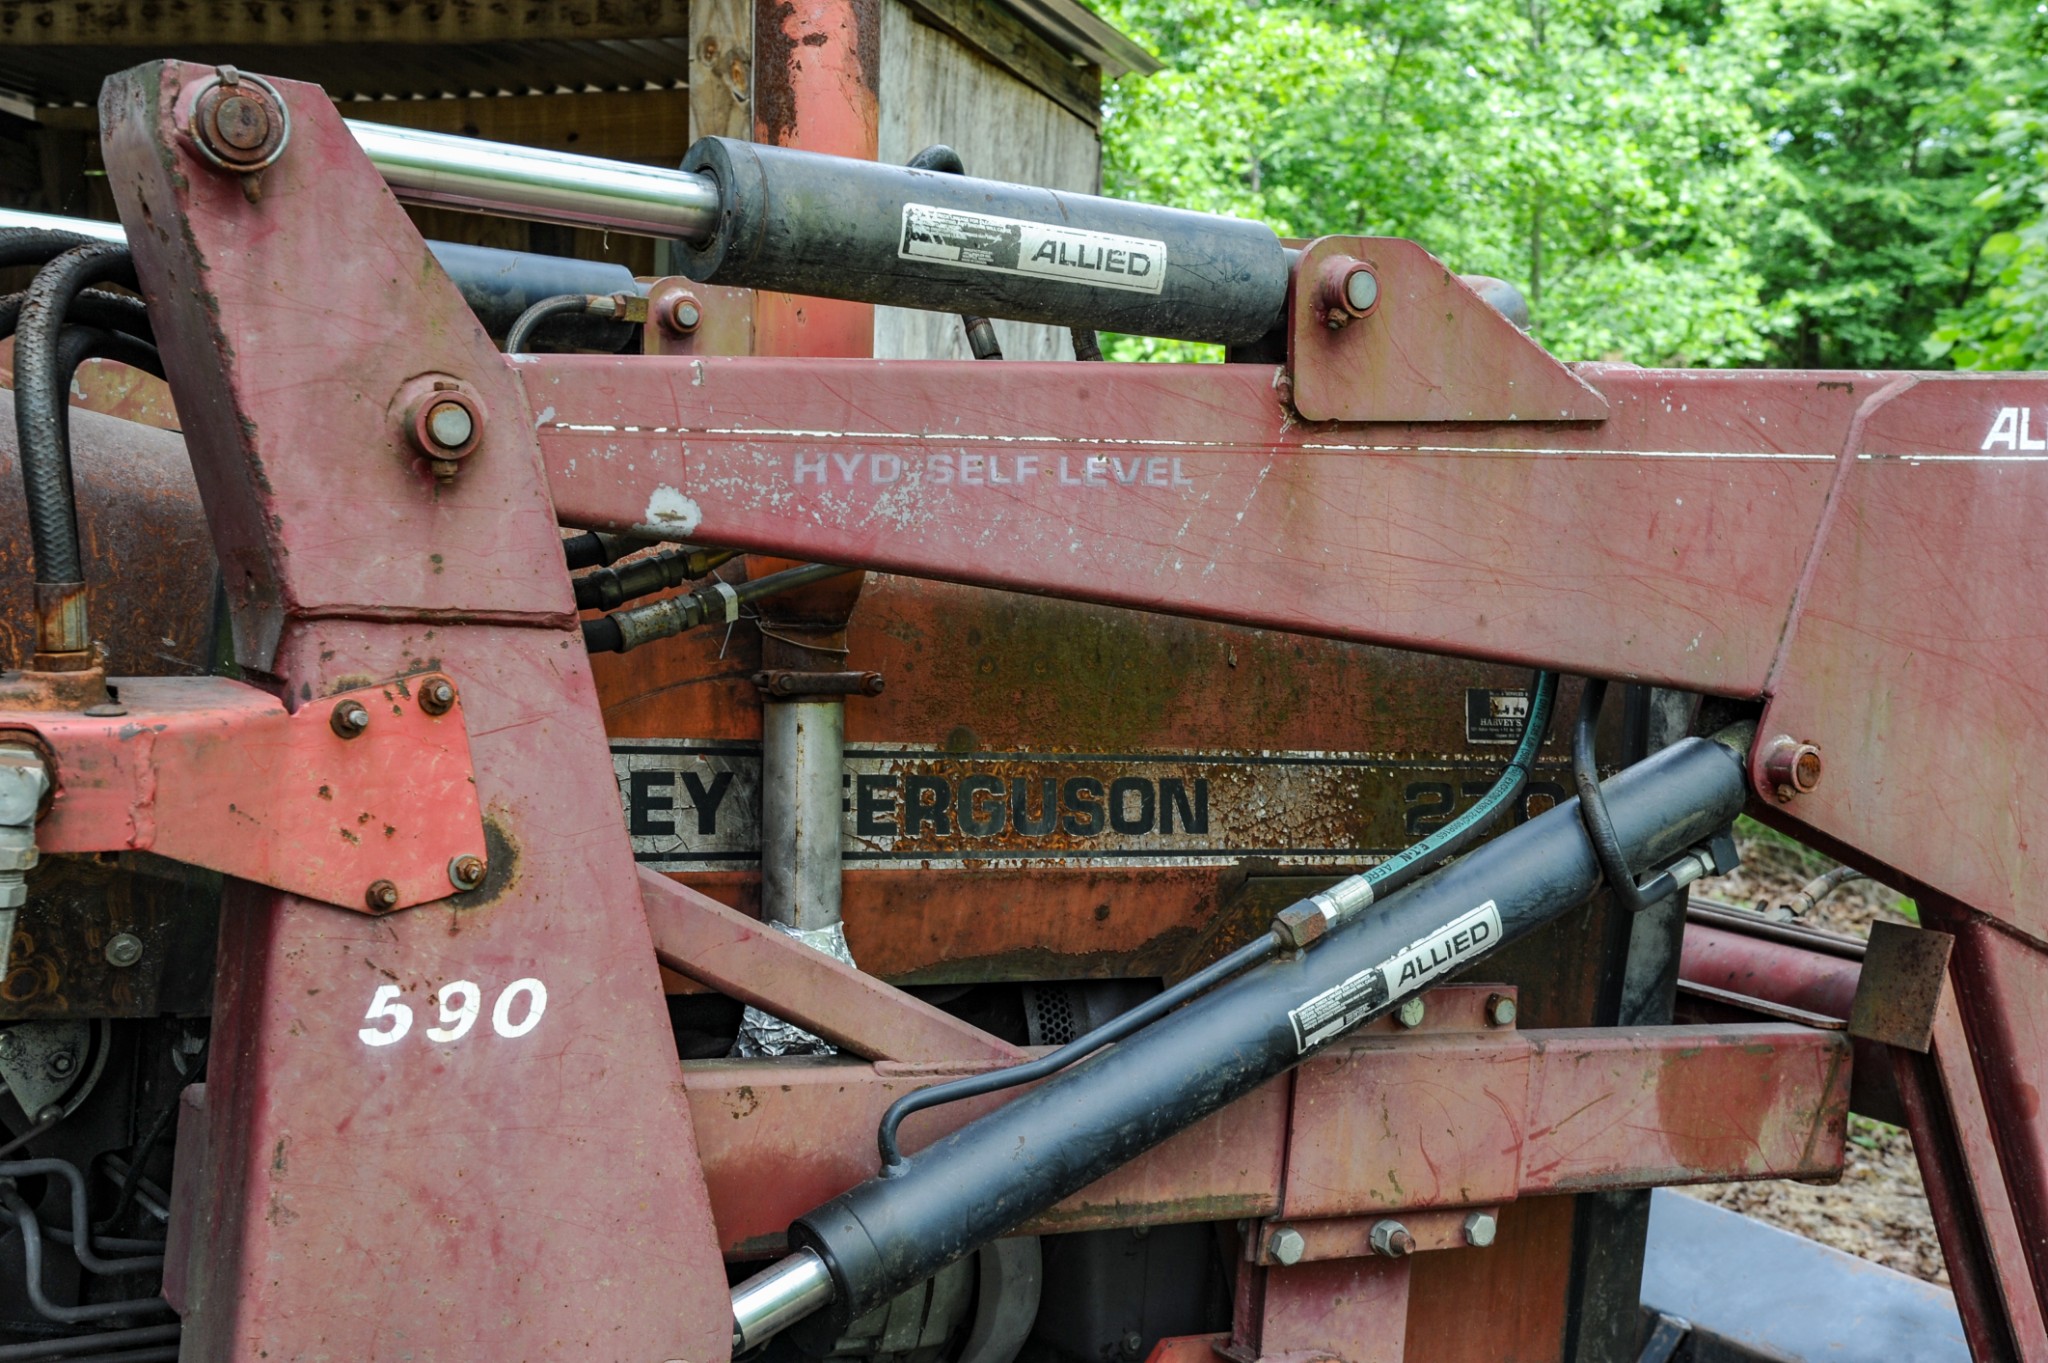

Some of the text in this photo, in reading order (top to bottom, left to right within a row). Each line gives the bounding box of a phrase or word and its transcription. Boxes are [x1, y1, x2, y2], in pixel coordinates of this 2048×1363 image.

[1031, 240, 1151, 276] ALLIED
[1981, 407, 2048, 450] AL
[794, 452, 1195, 488] HYD SELF LEVEL
[842, 774, 1209, 837] ERGUSON
[1398, 921, 1490, 988] ALLIED
[358, 977, 548, 1047] 590
